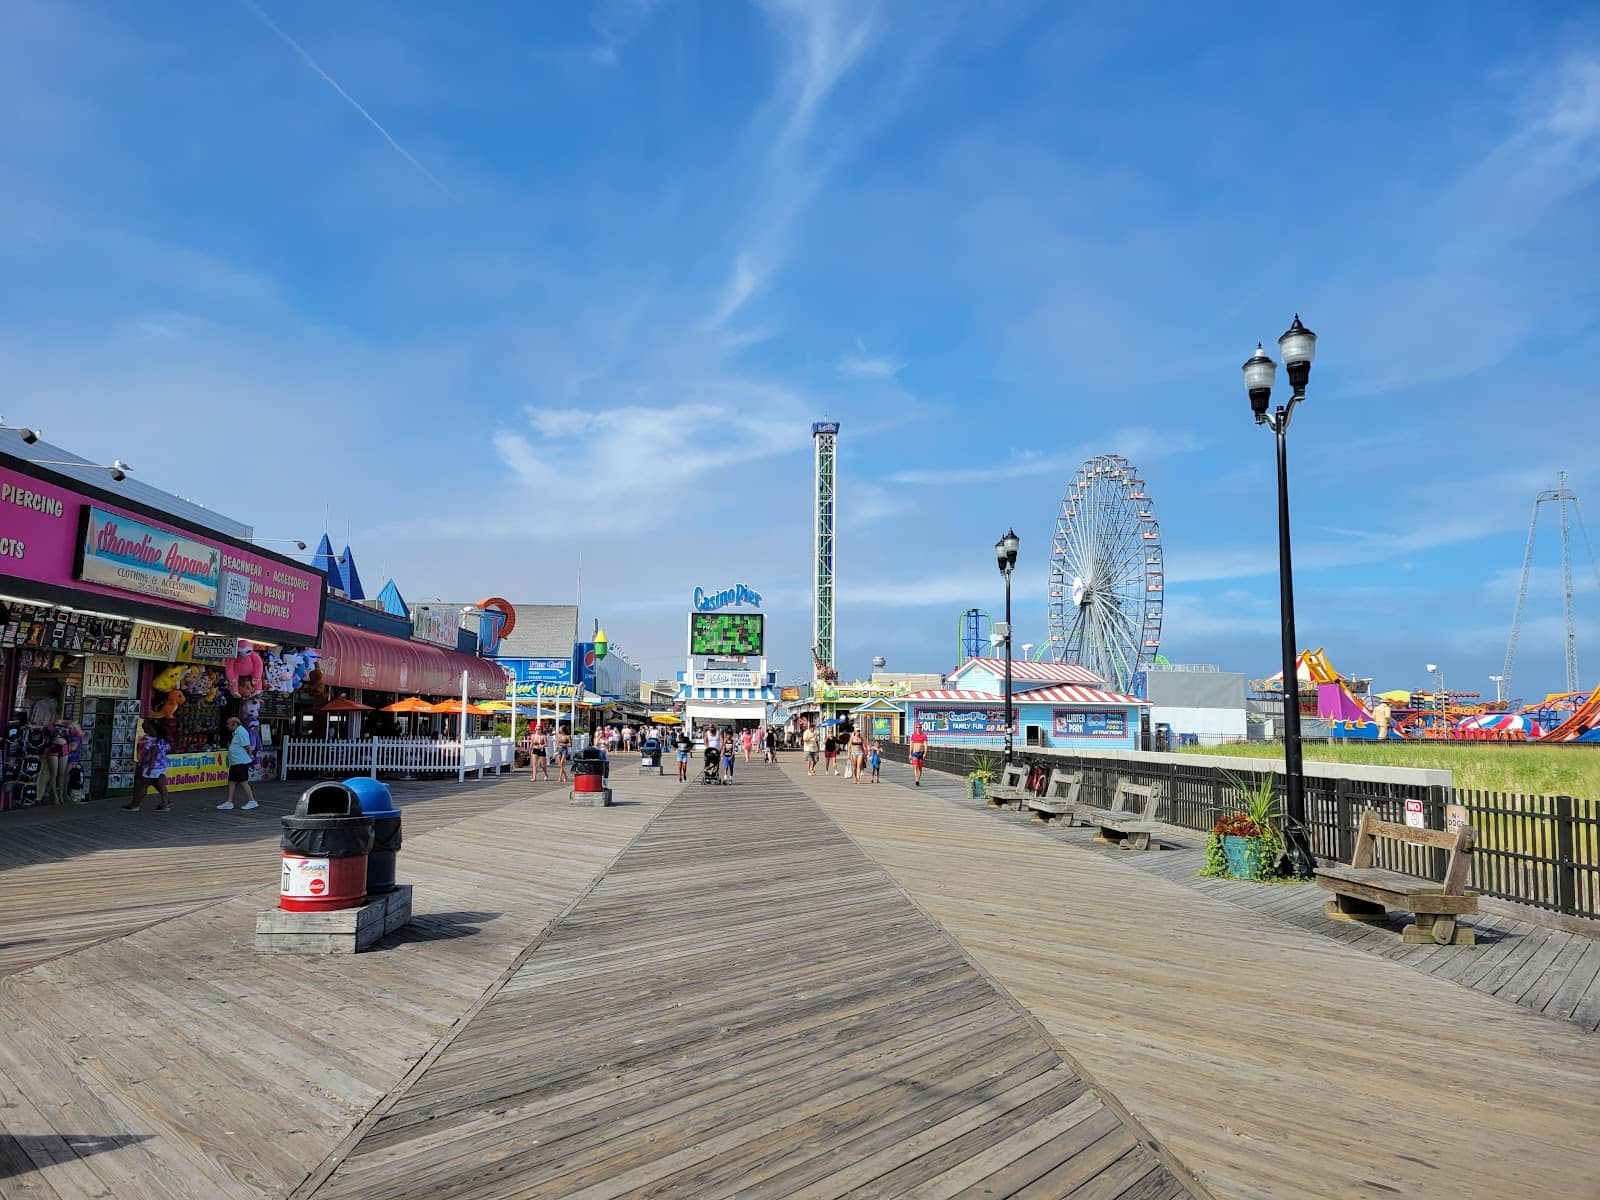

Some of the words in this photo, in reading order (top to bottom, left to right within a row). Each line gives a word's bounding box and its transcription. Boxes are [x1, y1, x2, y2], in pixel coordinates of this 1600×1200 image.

[1, 483, 63, 517] PIERCING
[97, 521, 162, 563] Shoreline
[164, 542, 211, 581] Apparel
[117, 567, 149, 583] CLOTHING
[222, 555, 262, 577] BEACHWEAR
[272, 570, 310, 591] ACCESSORIES
[264, 585, 286, 600] DESIGN
[693, 585, 736, 611] Casino
[735, 583, 763, 608] Pier
[263, 603, 290, 618] SUPPLIES
[139, 626, 169, 642] HENNA
[131, 638, 170, 652] TATTOOS
[196, 637, 234, 648] HENNA
[199, 647, 233, 655] TATTOOS
[92, 661, 126, 676] HENNA
[87, 674, 129, 688] TATTOOS
[839, 690, 869, 698] FROG
[870, 690, 895, 698] BOG
[1066, 713, 1085, 723] WATER
[1068, 724, 1083, 733] PARK
[176, 773, 199, 785] Balloon
[206, 771, 217, 782] You
[1408, 802, 1420, 811] NO
